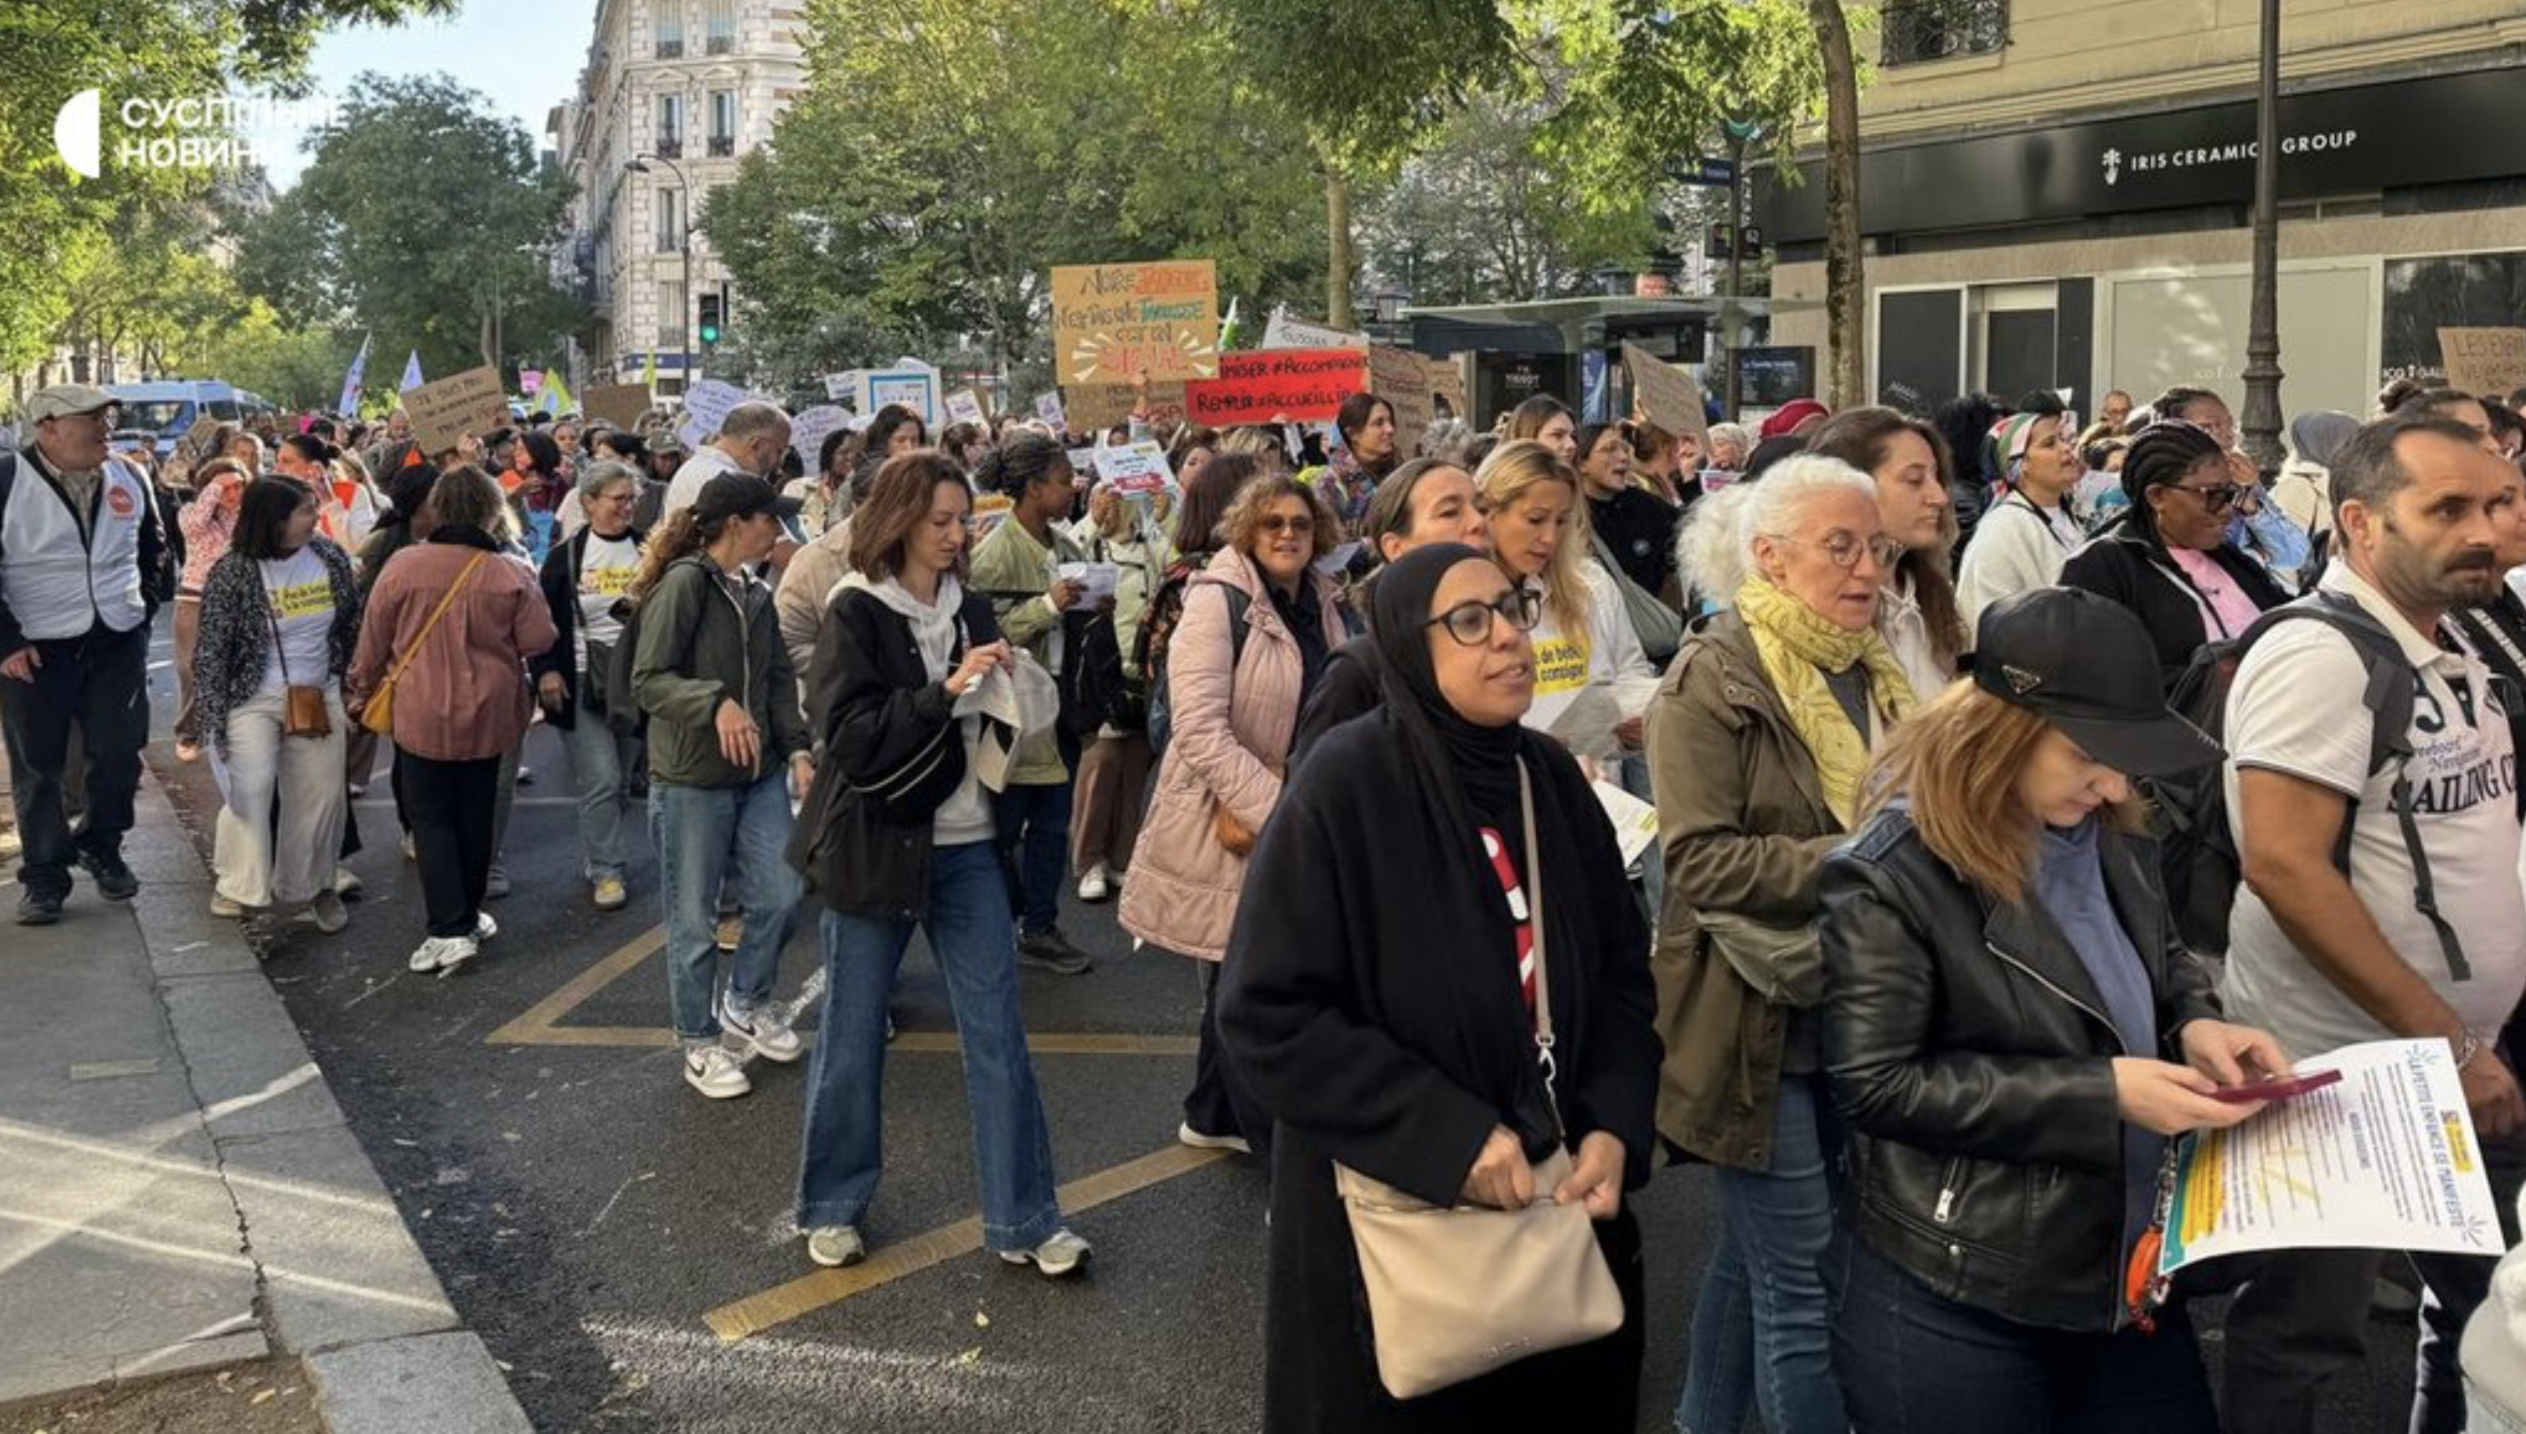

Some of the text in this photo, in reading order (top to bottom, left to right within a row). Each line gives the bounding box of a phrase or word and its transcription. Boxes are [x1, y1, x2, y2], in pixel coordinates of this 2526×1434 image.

[2131, 129, 2358, 172] IRIS CERAMIC GROUP
[1219, 356, 1268, 380] IMISER
[2386, 758, 2500, 815] SAILING
[2436, 1167, 2467, 1229] MANIFESTE
